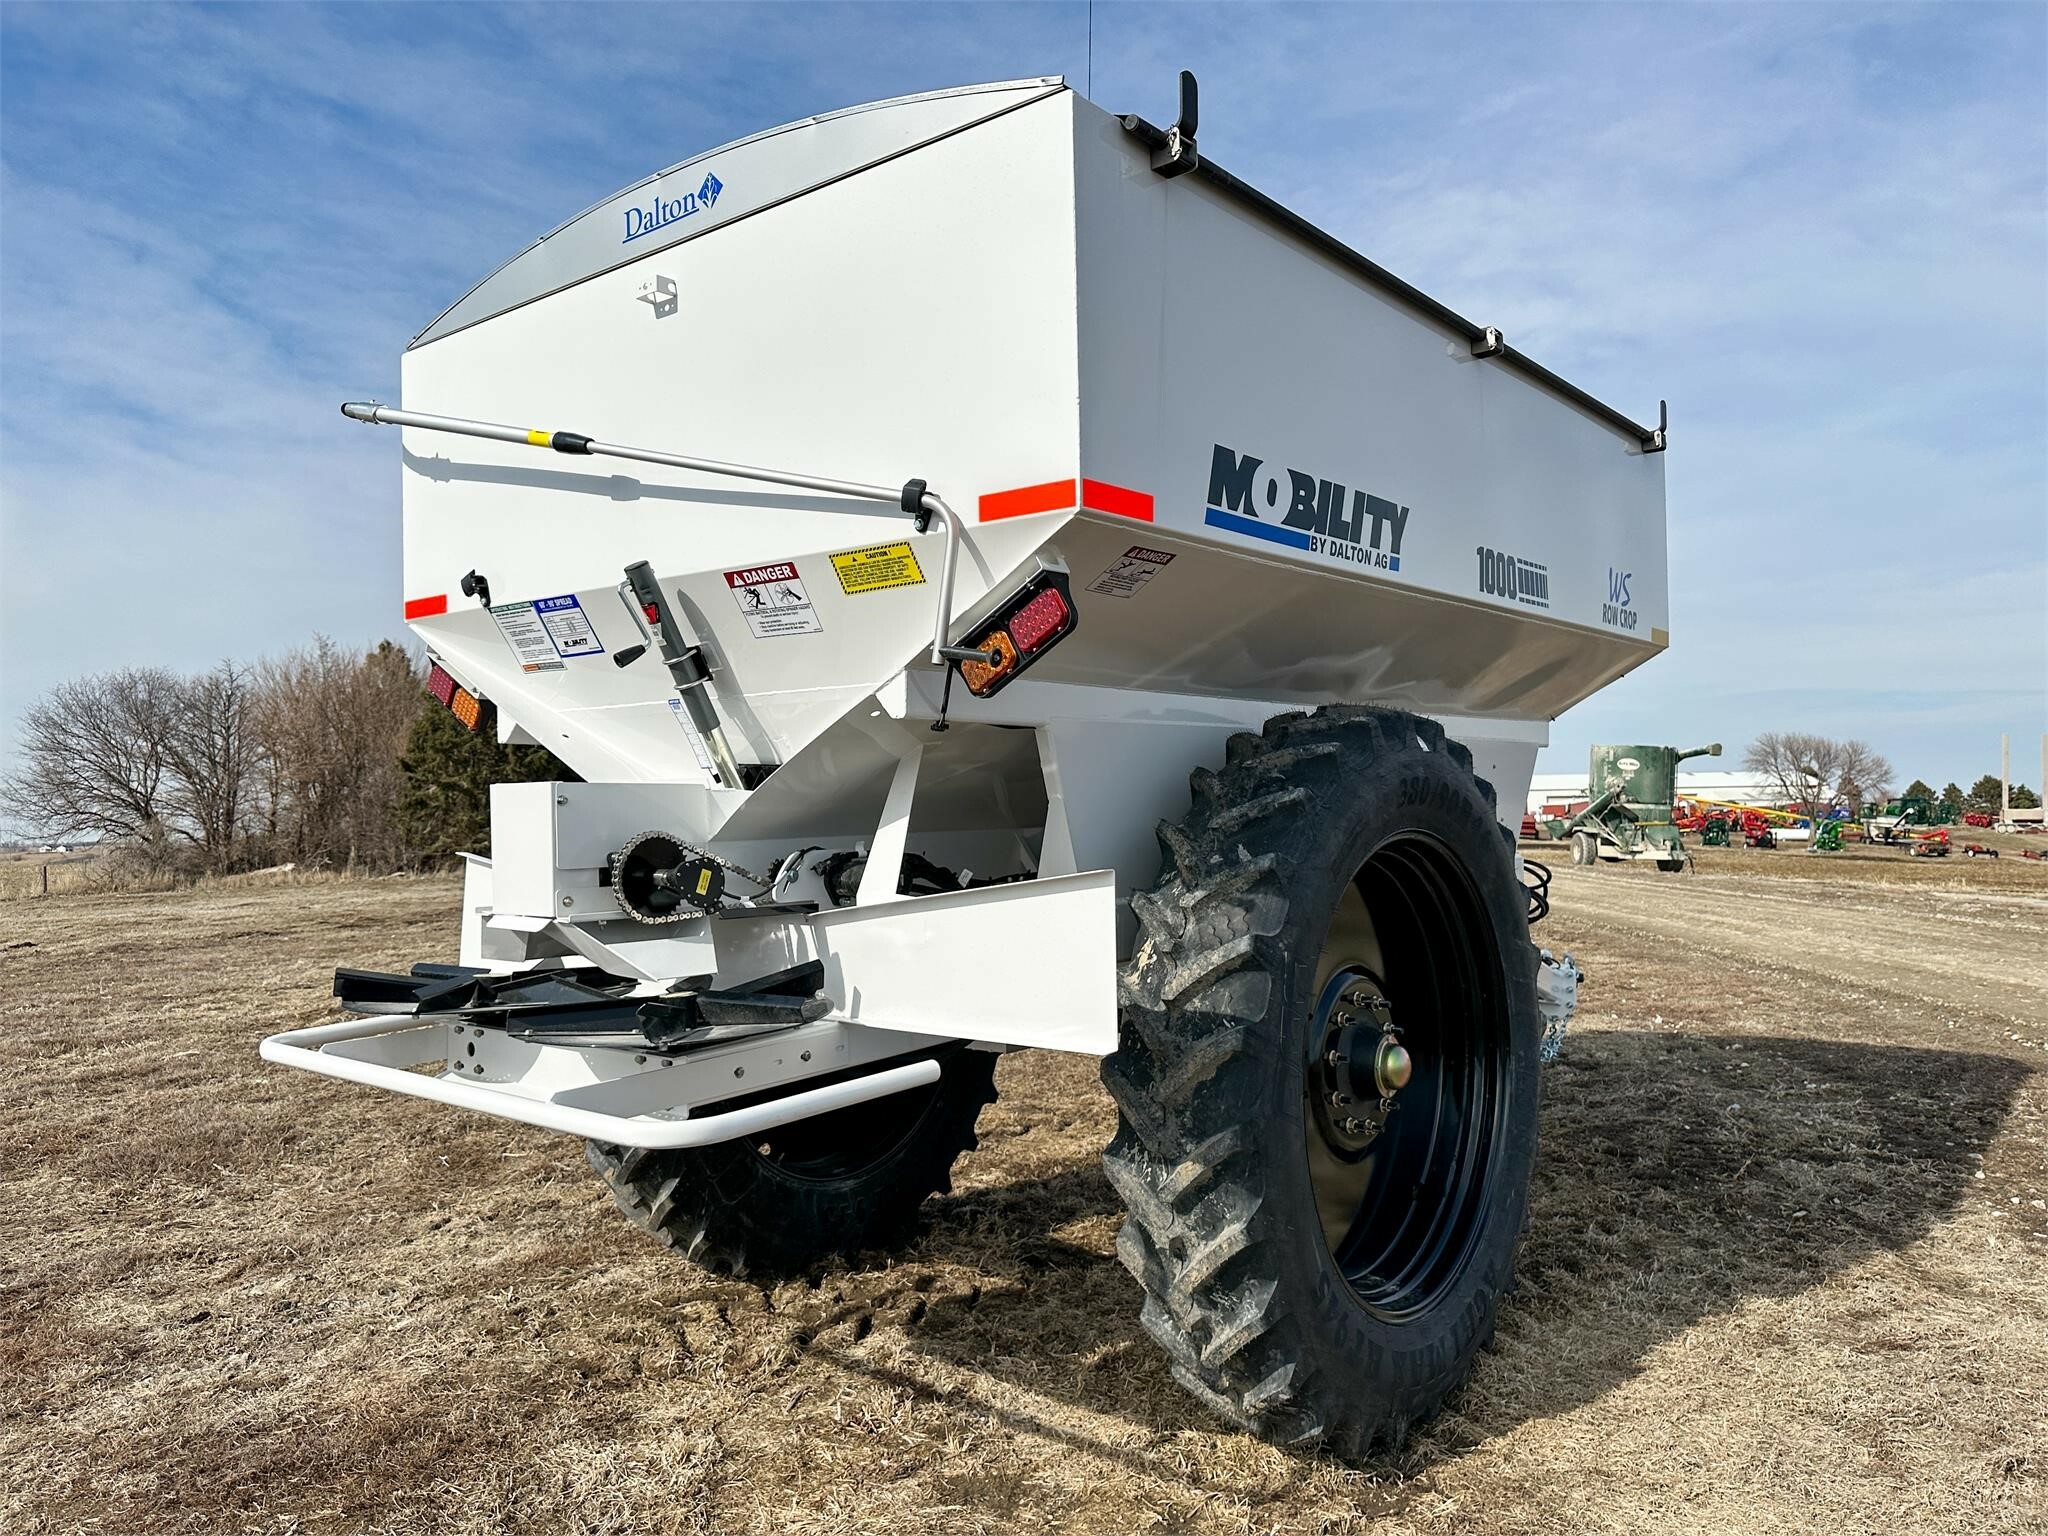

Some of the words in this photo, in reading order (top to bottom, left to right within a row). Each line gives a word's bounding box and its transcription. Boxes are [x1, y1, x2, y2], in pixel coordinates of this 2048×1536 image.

[623, 192, 700, 239] Dalton
[1206, 443, 1410, 555] MOBILITY
[864, 550, 889, 560] CAUTION
[1137, 549, 1171, 563] DANGER
[1310, 536, 1327, 554] BY
[1329, 540, 1372, 566] DALTON
[1374, 553, 1389, 570] AG
[743, 564, 794, 584] DANGER
[1476, 545, 1518, 601] 1000
[1602, 603, 1619, 626] ROW
[1619, 606, 1638, 631] CROP
